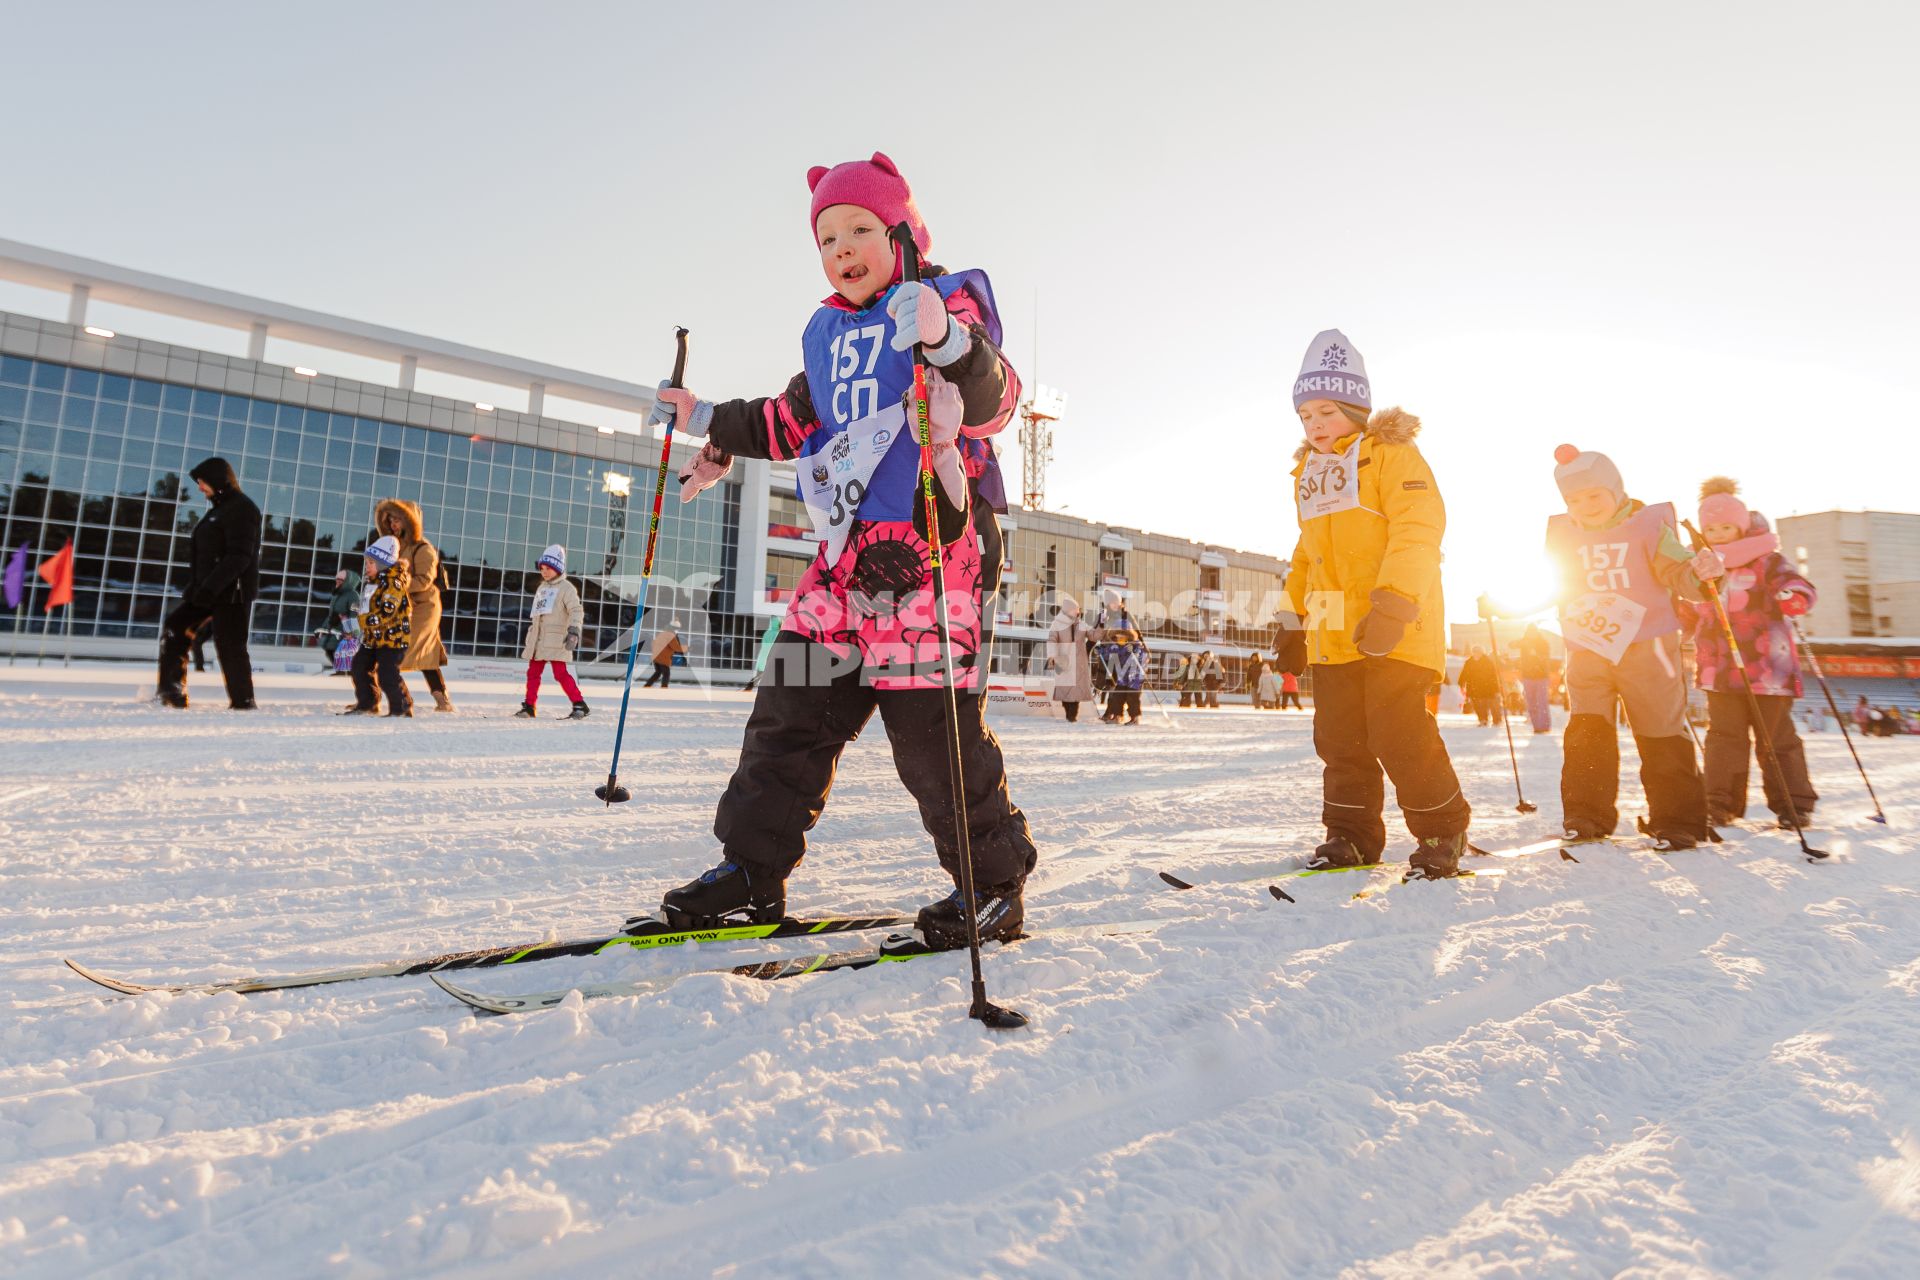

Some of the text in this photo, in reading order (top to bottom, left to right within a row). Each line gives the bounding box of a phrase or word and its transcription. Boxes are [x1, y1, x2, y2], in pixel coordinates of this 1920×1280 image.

[830, 324, 885, 382] 157
[832, 378, 879, 424] СП
[917, 400, 930, 446] SKI NINJA
[1577, 542, 1630, 570] 157
[1587, 567, 1631, 592] СП
[1576, 610, 1622, 644] 392
